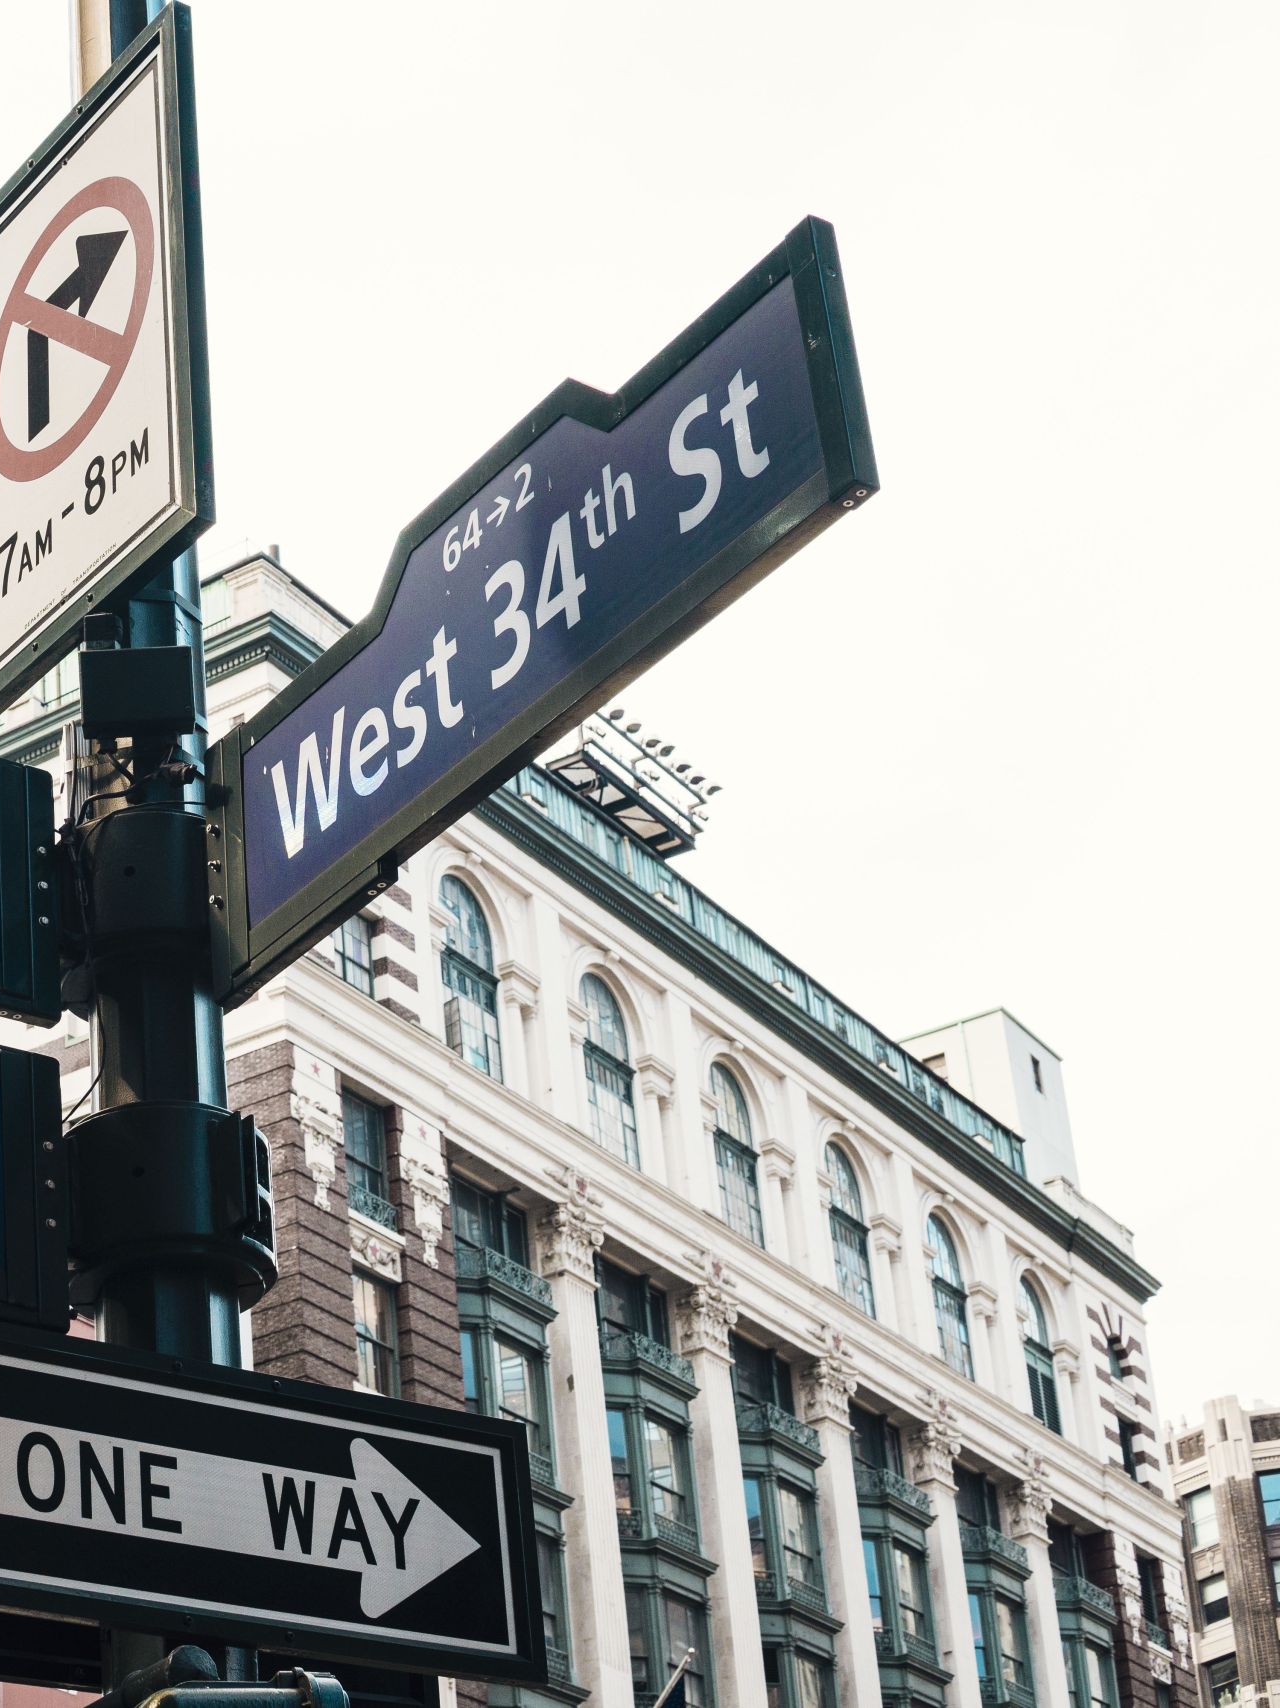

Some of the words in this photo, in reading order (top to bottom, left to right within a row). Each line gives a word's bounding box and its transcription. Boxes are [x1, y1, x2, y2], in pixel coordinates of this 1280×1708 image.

[84, 427, 149, 515] 8PM
[23, 598, 56, 630] DEPARTMENT
[72, 542, 118, 585] TRANSPORTATION
[270, 624, 464, 860] West
[483, 462, 636, 691] 34th
[668, 368, 770, 534] St
[16, 1431, 183, 1535] ONE
[261, 1472, 421, 1571] WAY
